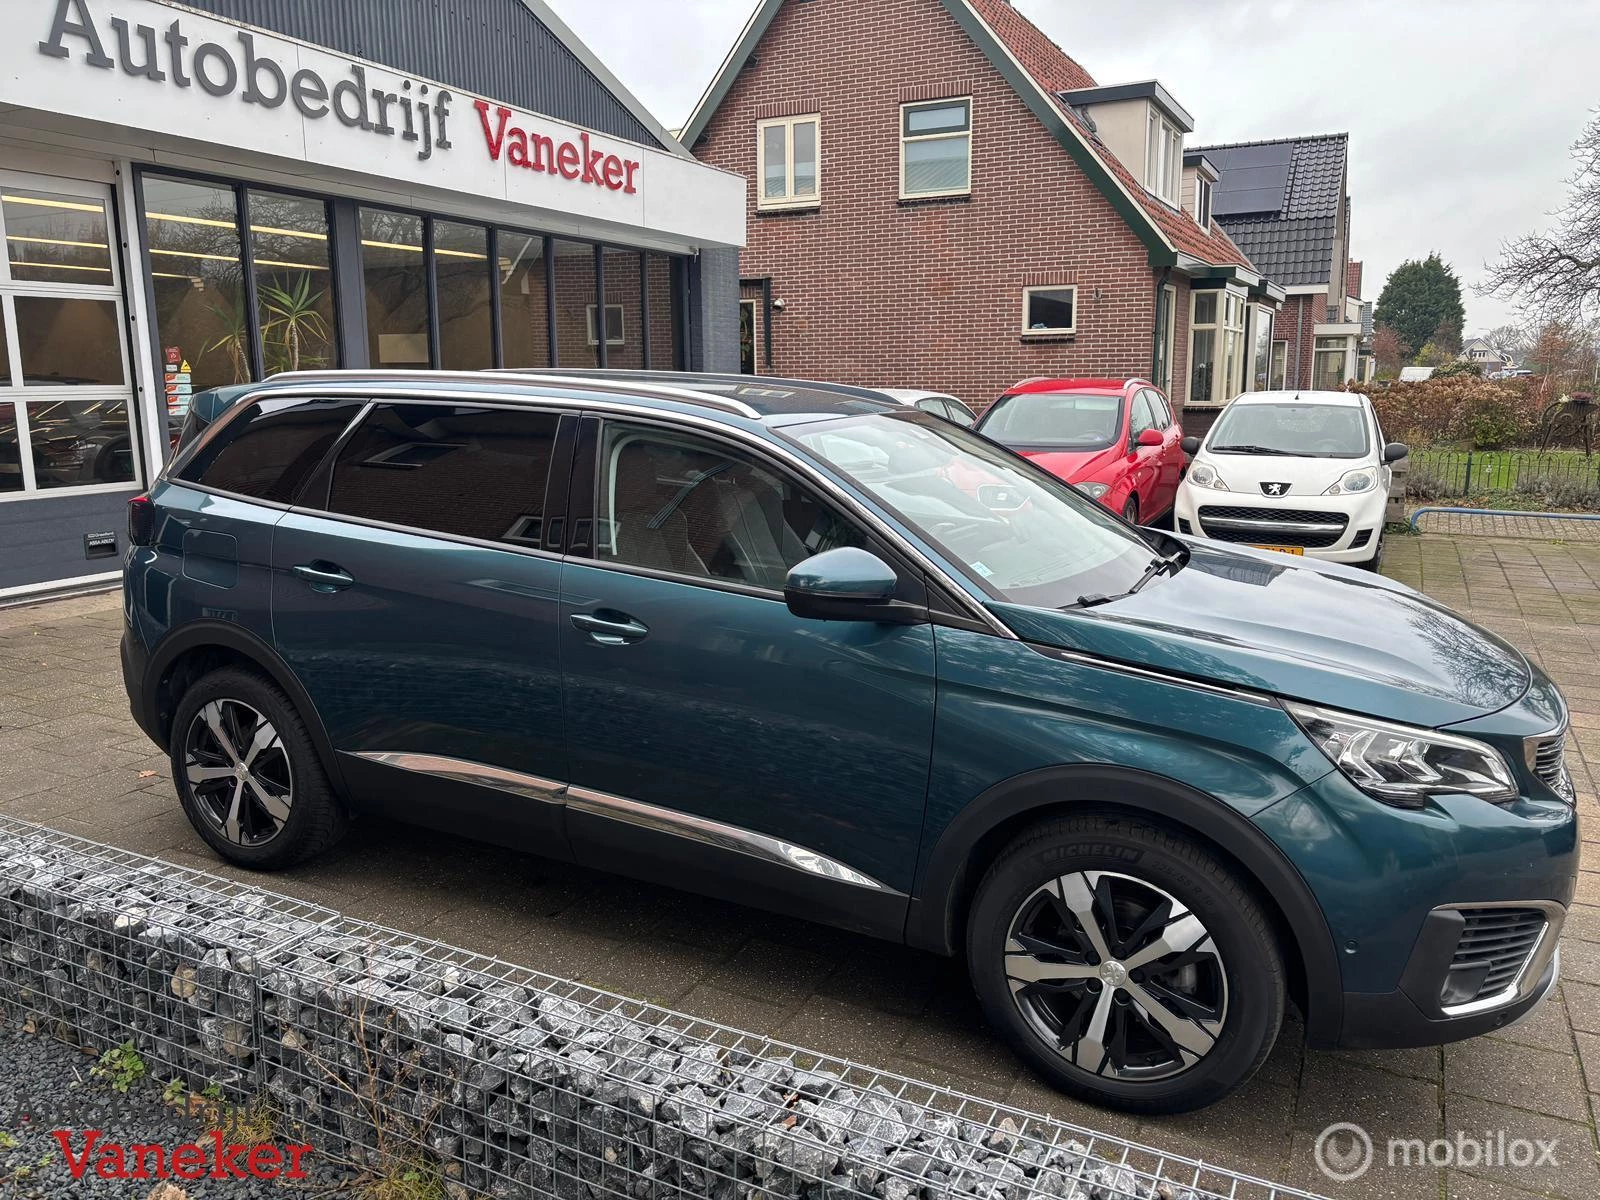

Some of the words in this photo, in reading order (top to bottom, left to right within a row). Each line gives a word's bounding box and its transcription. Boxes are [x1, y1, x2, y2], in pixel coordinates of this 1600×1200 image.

[39, 0, 453, 161] Autobedrijf
[474, 99, 640, 194] Vaneker
[1042, 844, 1140, 861] MICHELIN
